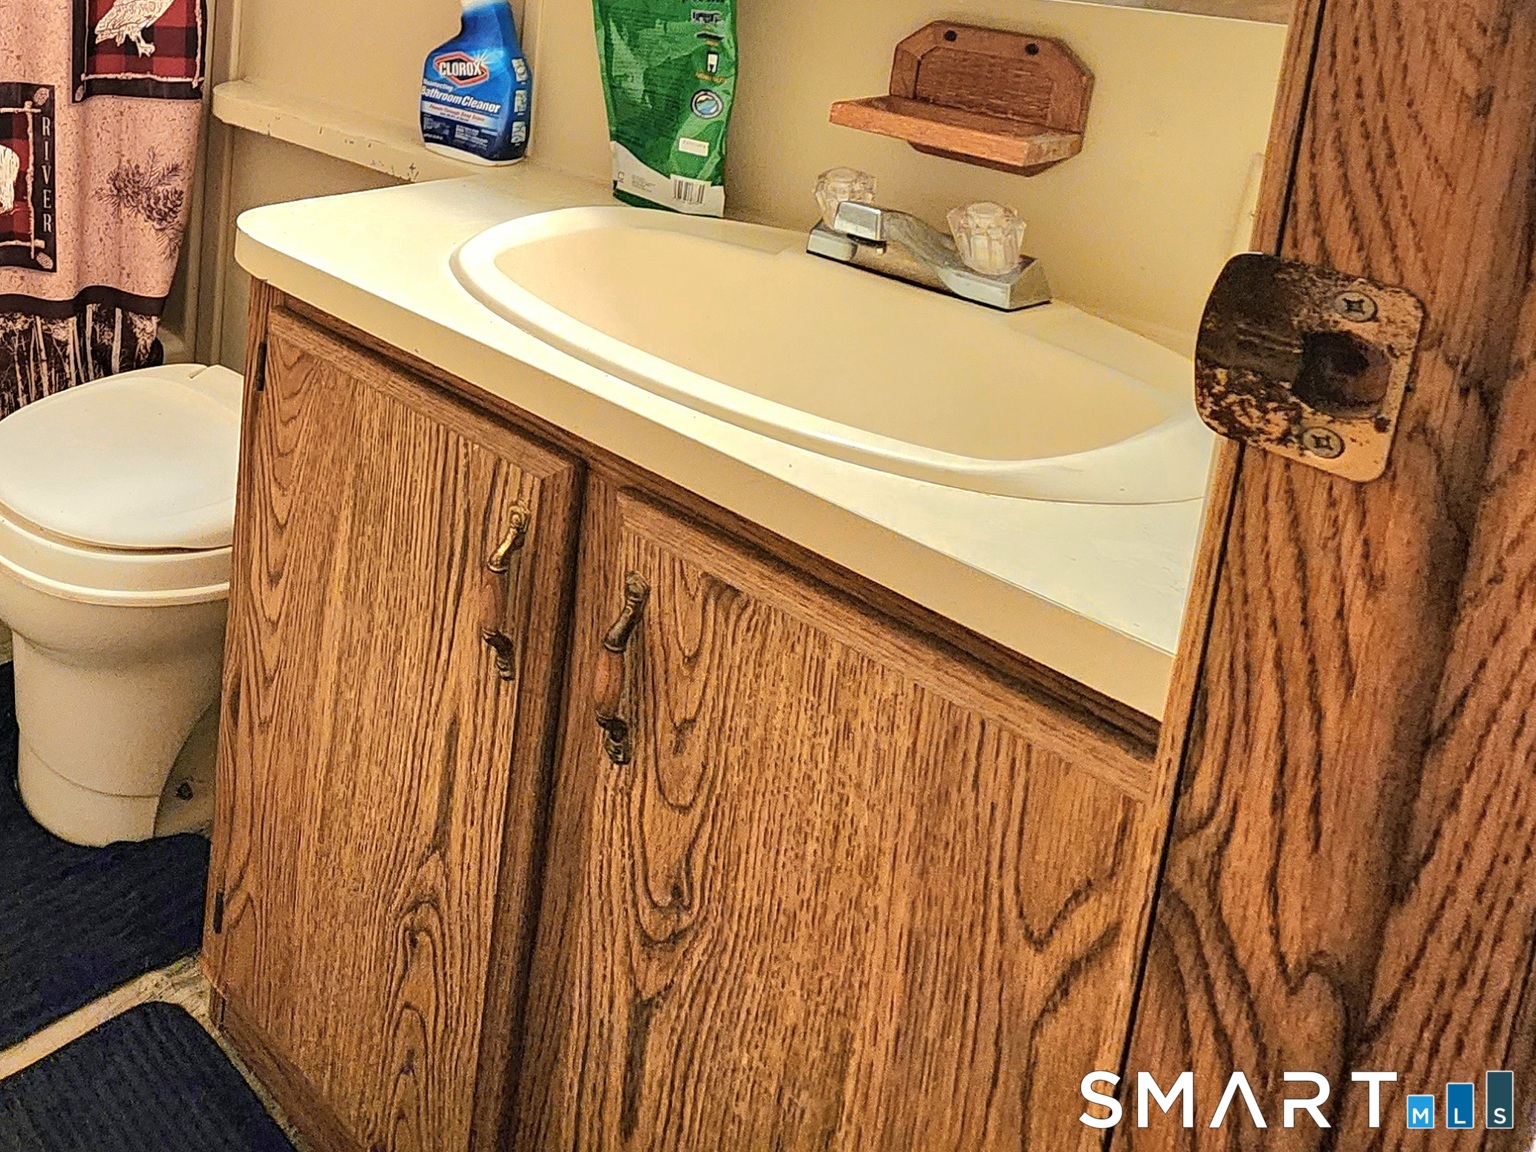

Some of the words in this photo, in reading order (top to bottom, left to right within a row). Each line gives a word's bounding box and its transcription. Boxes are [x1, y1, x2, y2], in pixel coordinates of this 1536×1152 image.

[439, 60, 482, 77] CLOROX
[461, 95, 501, 113] Cleaner
[41, 116, 52, 233] RIVER
